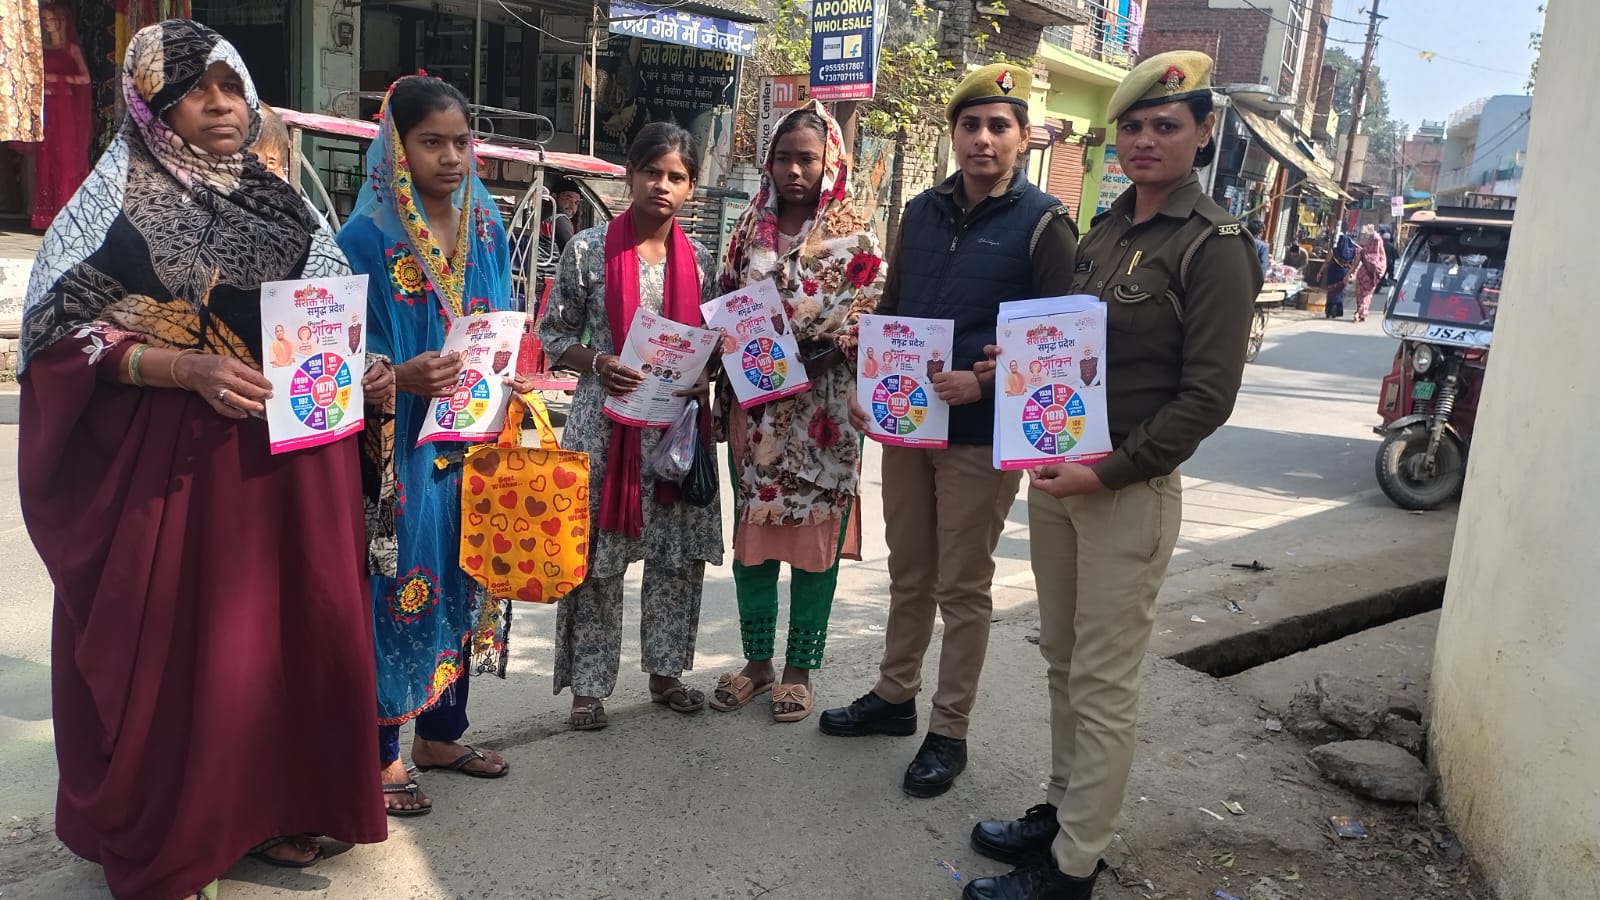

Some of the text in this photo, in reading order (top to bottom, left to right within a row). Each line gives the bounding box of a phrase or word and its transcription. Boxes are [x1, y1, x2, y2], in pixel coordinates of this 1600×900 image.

[814, 0, 873, 17] APOORVA
[622, 13, 648, 35] जय
[652, 15, 678, 41] गंगे
[682, 20, 700, 44] माँ
[814, 16, 873, 33] WHOLESALE
[825, 62, 864, 72] 9555517807
[825, 72, 863, 82] 7307071115
[761, 81, 771, 120] Center
[759, 124, 770, 165] Service
[307, 302, 344, 318] समृद्ध प्रदेश
[1037, 338, 1075, 353] समृद्ध प्रदेश
[316, 381, 334, 394] 1076
[891, 397, 908, 407] 1076
[1045, 409, 1064, 421] 1076
[498, 475, 514, 483] Best
[492, 579, 510, 588] Good
[492, 586, 511, 595] Luck!
